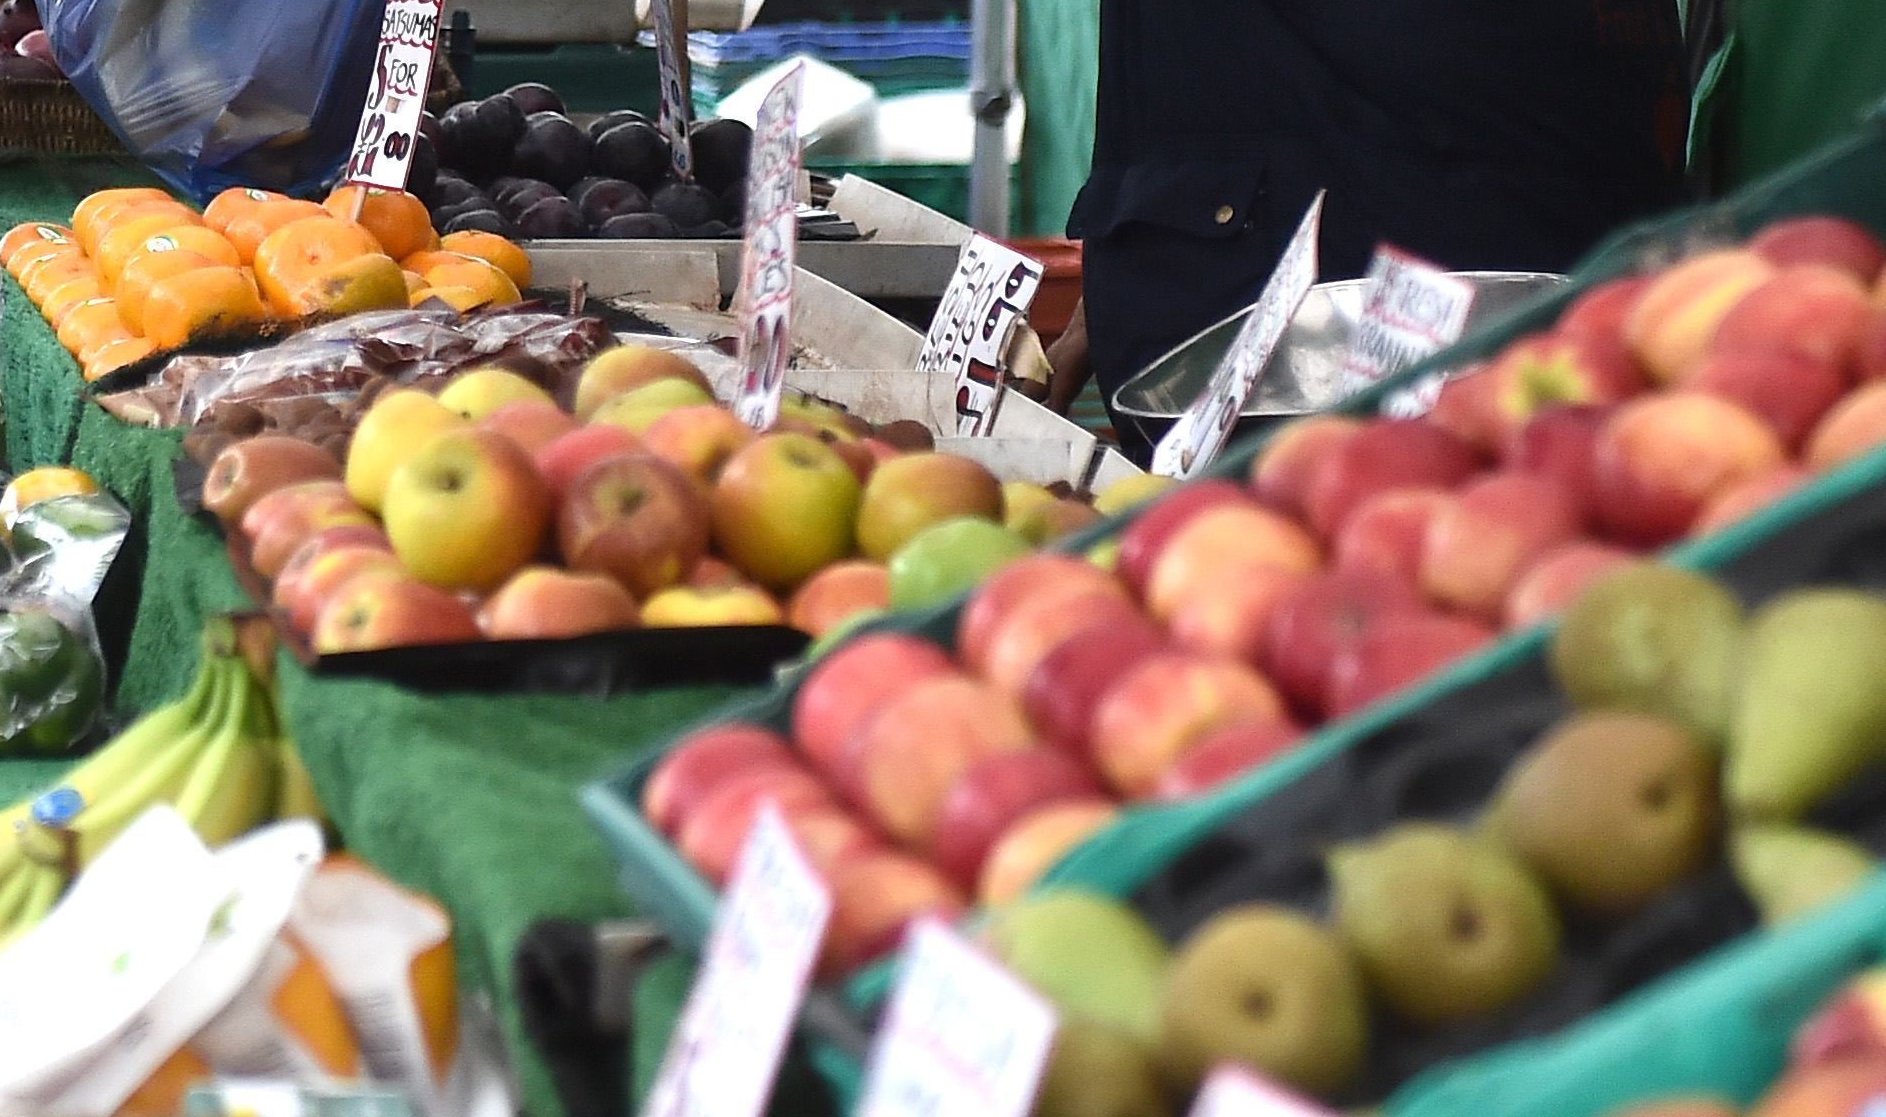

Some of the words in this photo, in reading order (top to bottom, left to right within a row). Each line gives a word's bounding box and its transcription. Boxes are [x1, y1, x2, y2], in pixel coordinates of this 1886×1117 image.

[381, 8, 437, 41] SATSUMAS
[367, 44, 393, 110] 5
[390, 58, 418, 90] FOR
[951, 281, 995, 364] IGS
